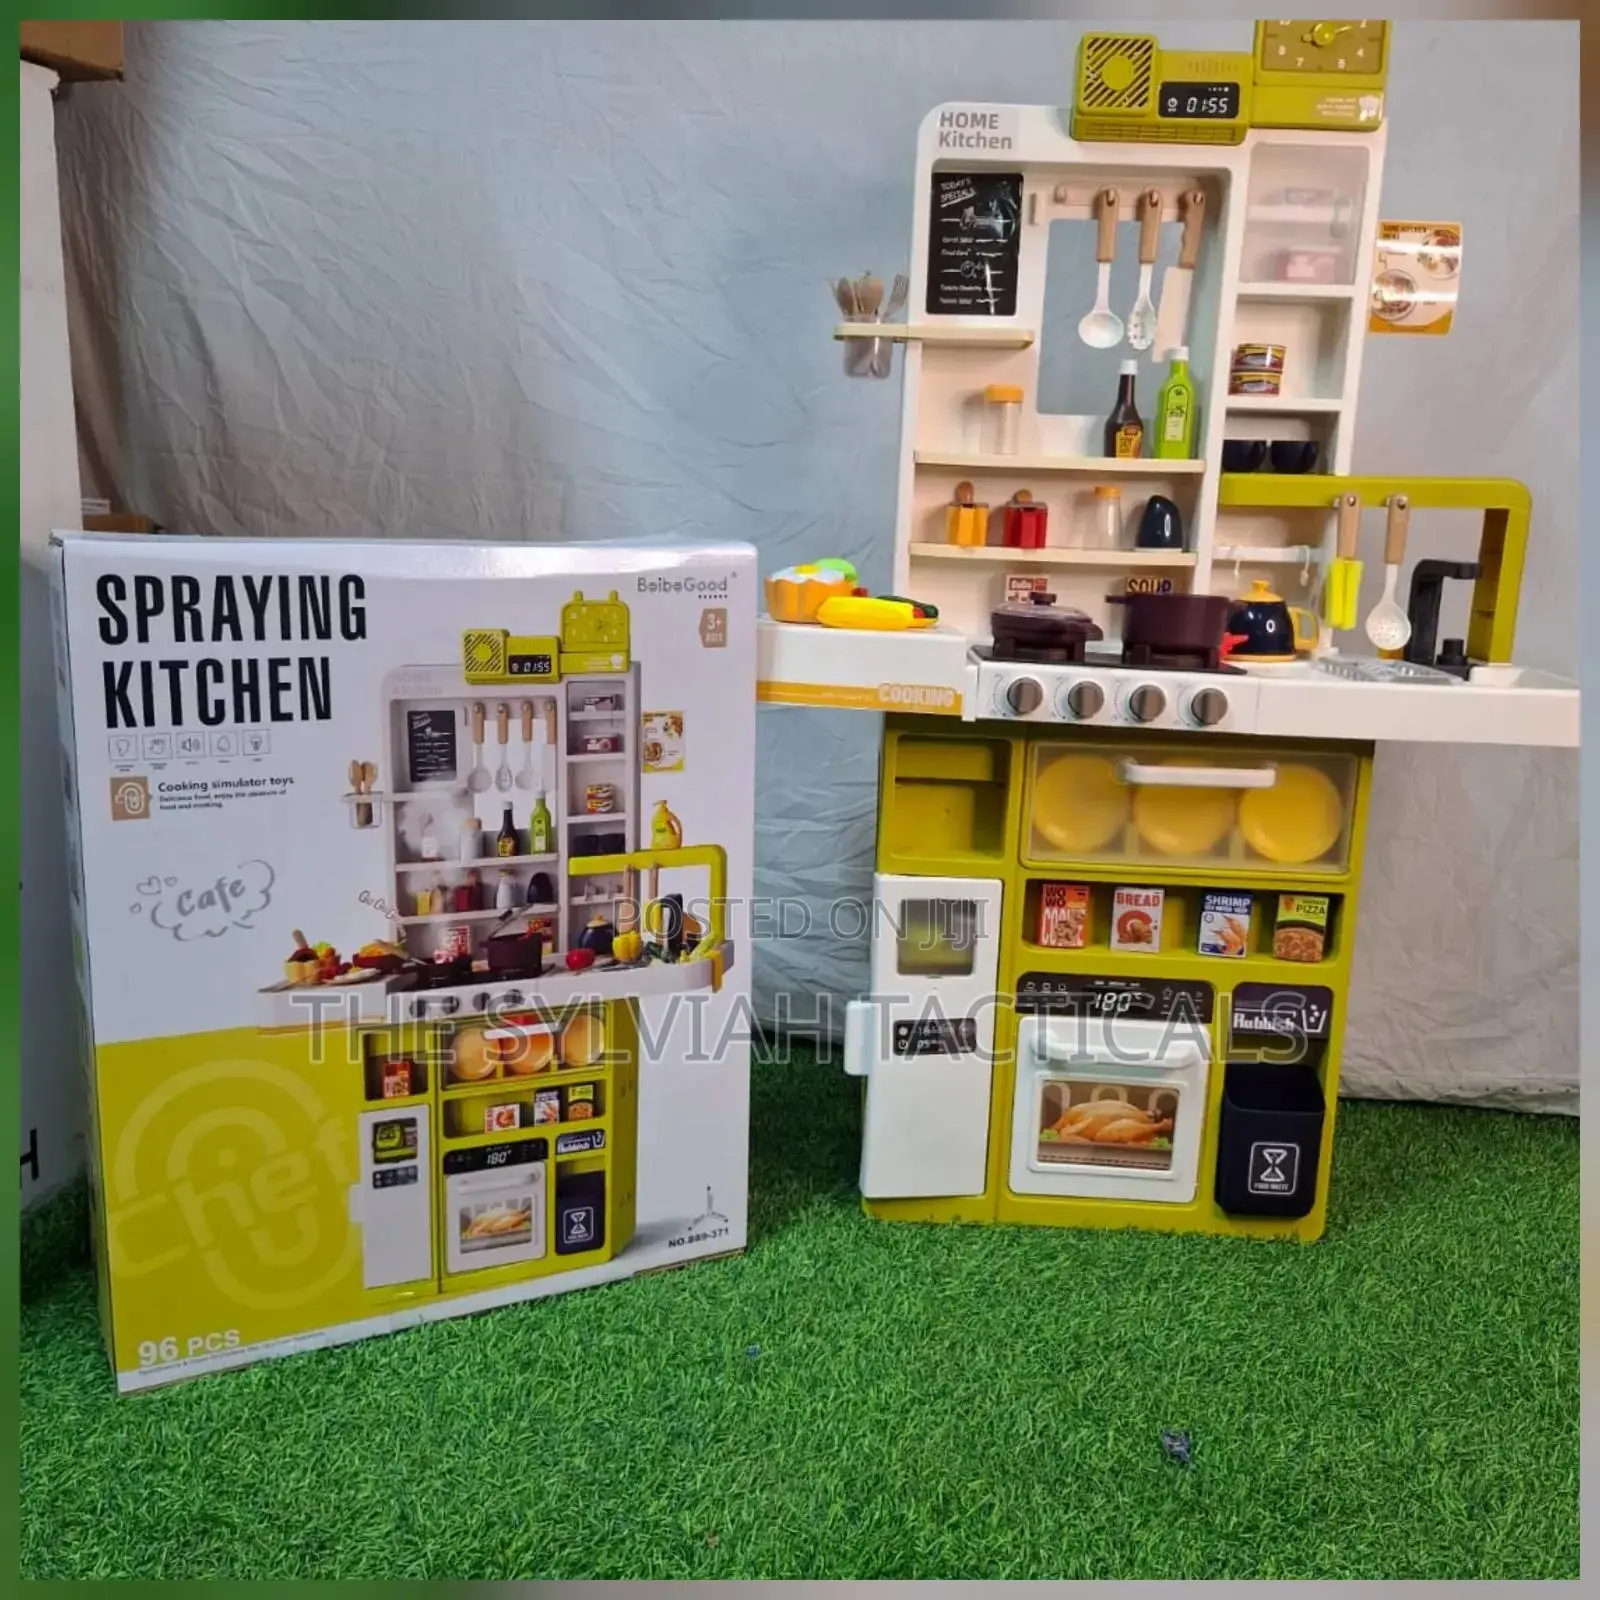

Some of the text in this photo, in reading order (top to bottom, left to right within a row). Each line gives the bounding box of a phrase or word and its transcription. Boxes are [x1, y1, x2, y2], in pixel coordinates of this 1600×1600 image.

[940, 111, 999, 130] HOME
[939, 130, 1013, 150] Kitchen
[1128, 578, 1172, 594] SOUP
[96, 574, 368, 646] SPRAYING
[102, 656, 333, 729] KITCHEN
[879, 682, 955, 708] COOKING
[158, 776, 294, 792] Cooking simulator toys
[1115, 891, 1161, 907] BREAD
[1204, 894, 1251, 908] SHRIMP
[1296, 904, 1325, 914] PIZZA
[138, 1336, 180, 1368] 96
[187, 1328, 241, 1357] PCS
